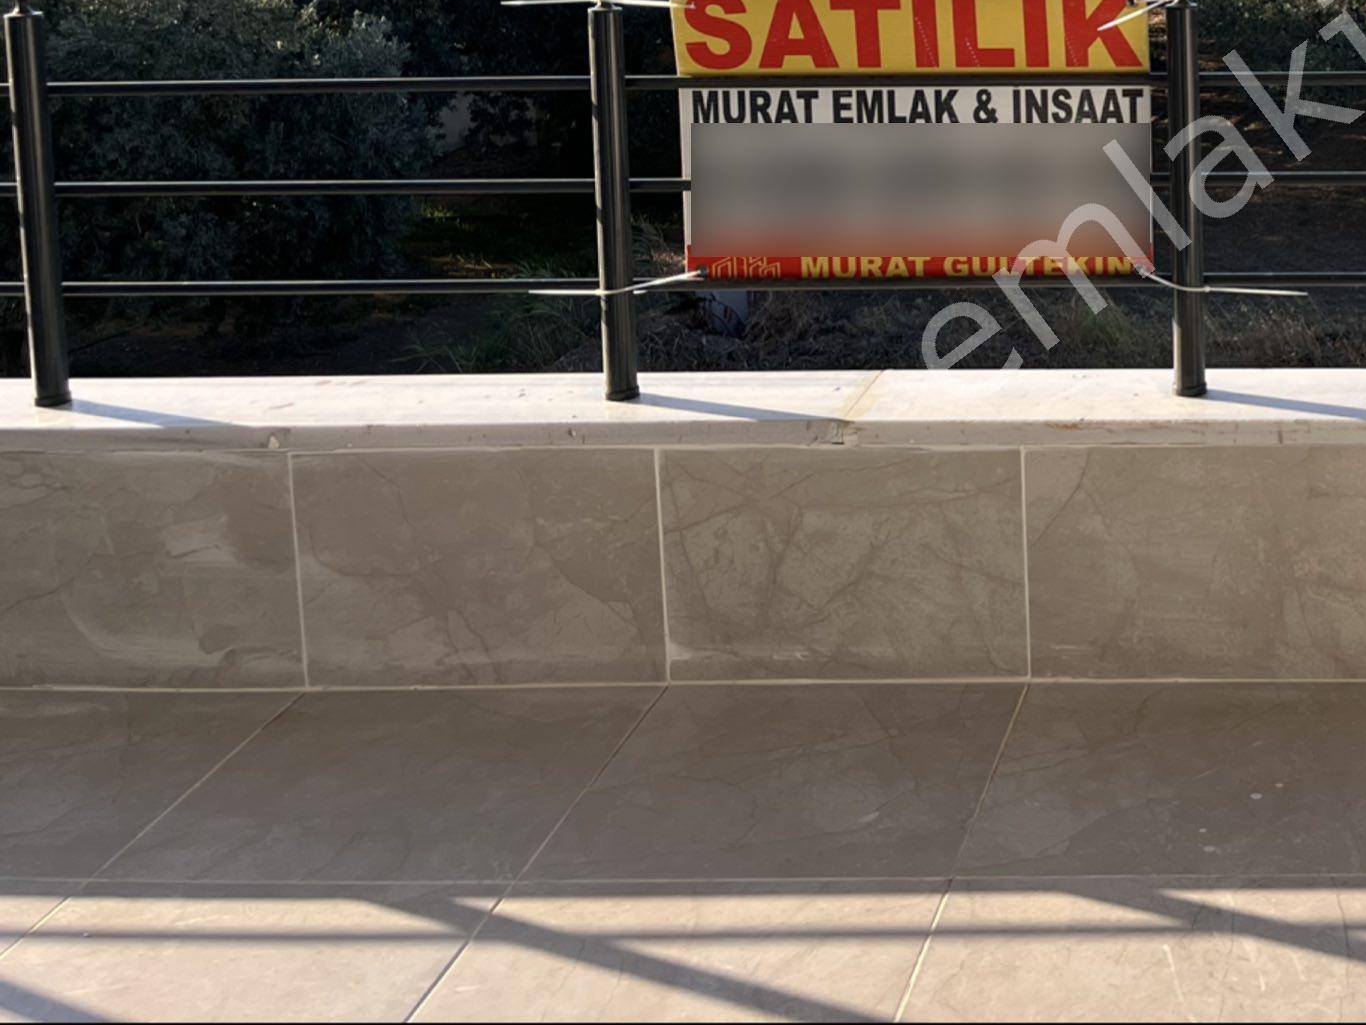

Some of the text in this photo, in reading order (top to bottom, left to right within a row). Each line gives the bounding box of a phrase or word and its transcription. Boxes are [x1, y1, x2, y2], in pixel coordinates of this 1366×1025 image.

[692, 89, 819, 124] MURAT
[831, 89, 959, 124] EMLAK
[972, 88, 998, 124] &
[800, 256, 931, 278] MURAT
